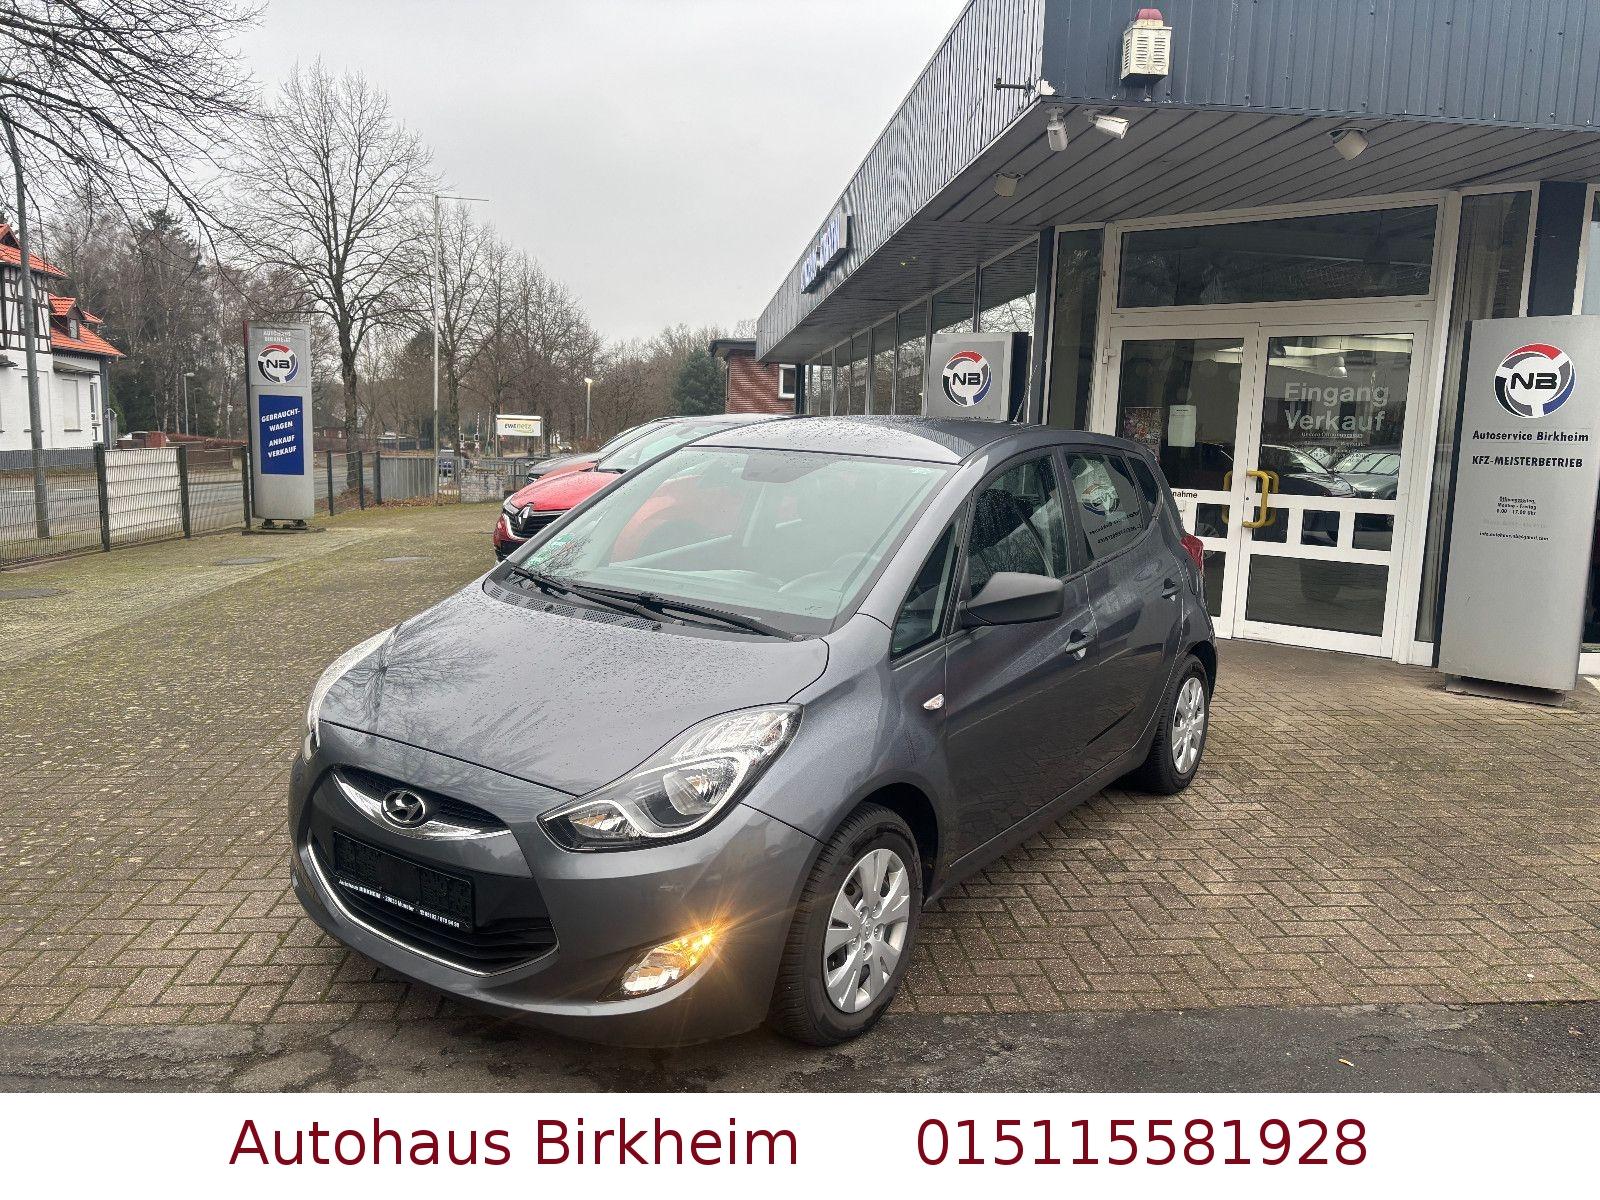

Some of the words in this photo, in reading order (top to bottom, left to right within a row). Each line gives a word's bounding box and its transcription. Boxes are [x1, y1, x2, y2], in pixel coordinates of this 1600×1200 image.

[266, 359, 290, 368] NB
[952, 372, 981, 386] NB
[1510, 372, 1558, 390] NB
[1284, 382, 1389, 407] Eingang
[261, 408, 300, 423] GEBRAUCHT-
[1286, 410, 1385, 431] Verkauf
[269, 421, 293, 432] WAGEN
[268, 434, 295, 447] ANKAUF
[1472, 430, 1533, 441] Autoservice
[1536, 430, 1589, 442] Birkheim
[267, 446, 297, 458] VERKAUF
[1472, 456, 1583, 468] KFZ-MEISTERBETRIEB
